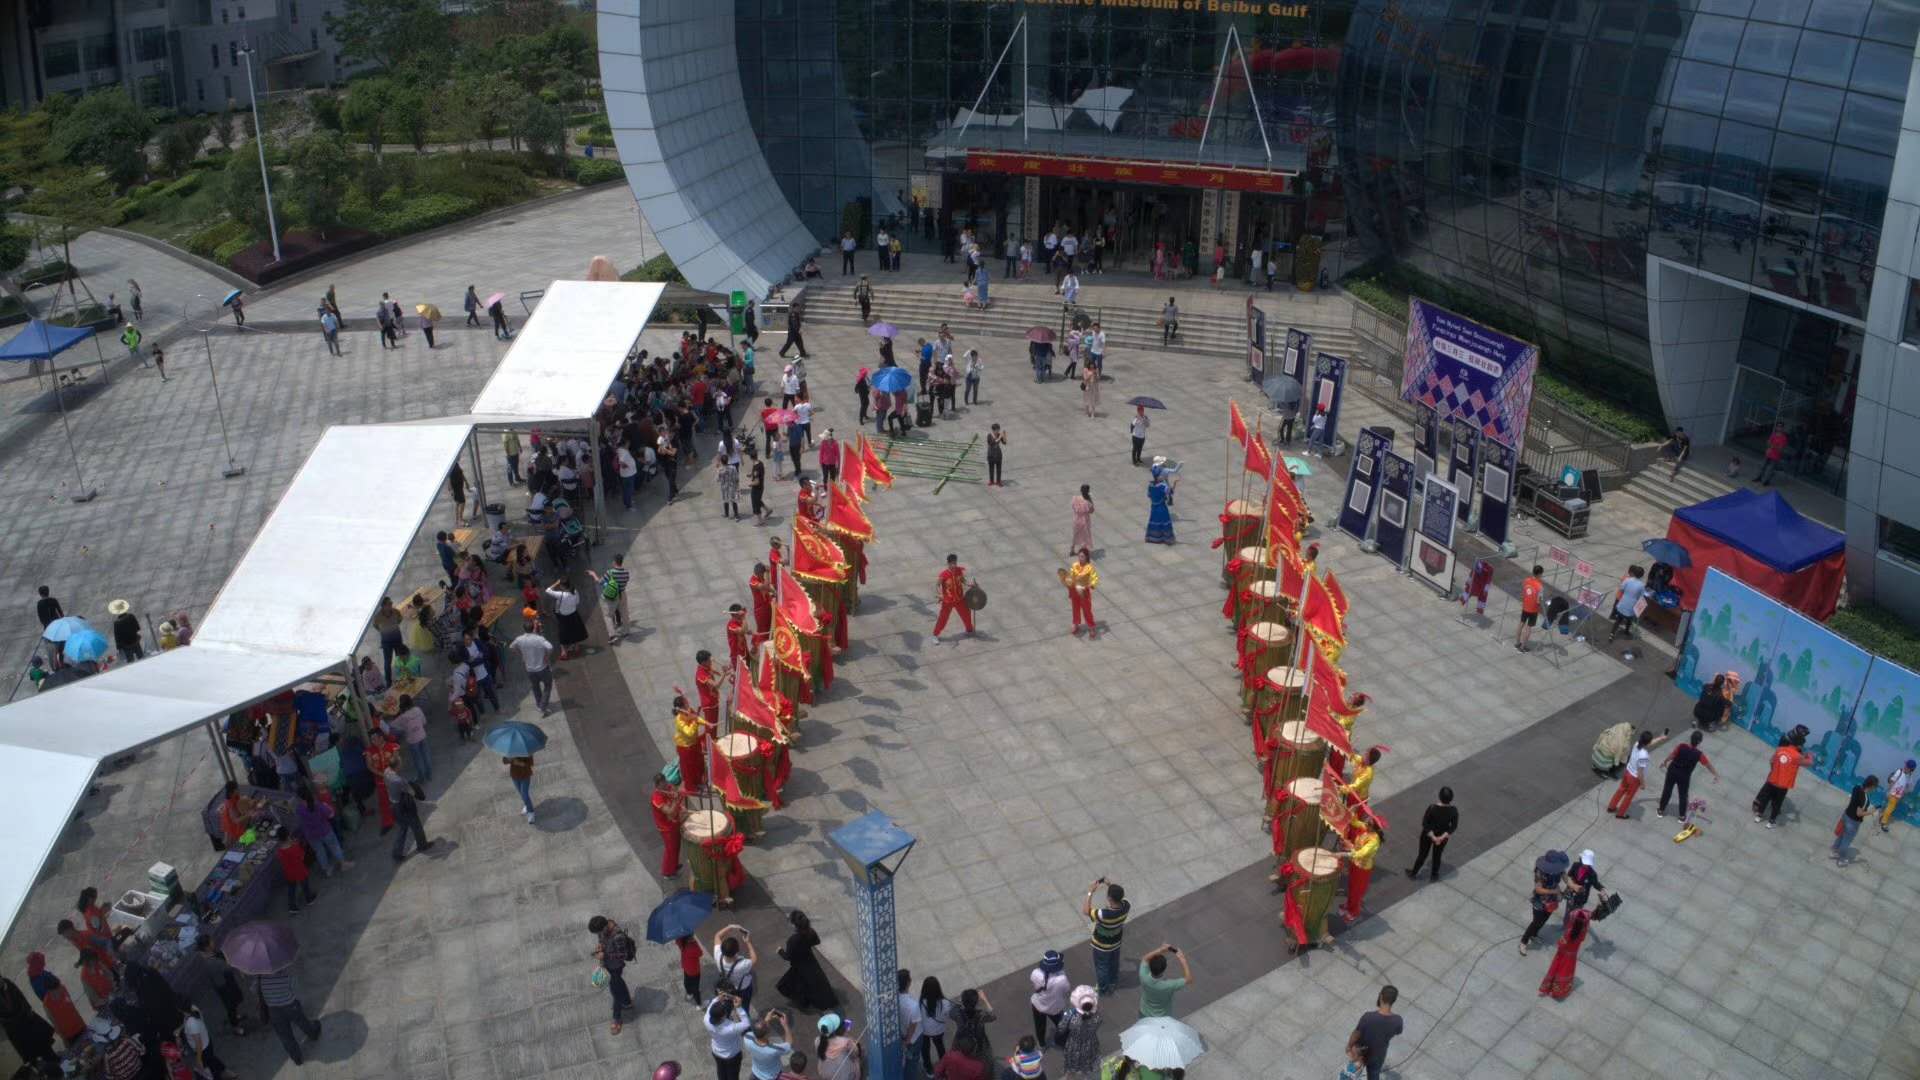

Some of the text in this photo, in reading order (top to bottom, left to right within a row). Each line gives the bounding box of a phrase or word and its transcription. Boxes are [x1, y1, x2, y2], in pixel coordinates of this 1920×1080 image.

[1101, 0, 1178, 9] Museum
[1183, 0, 1201, 11] of
[1208, 0, 1262, 14] Beibu
[1268, 3, 1310, 17] Gulf
